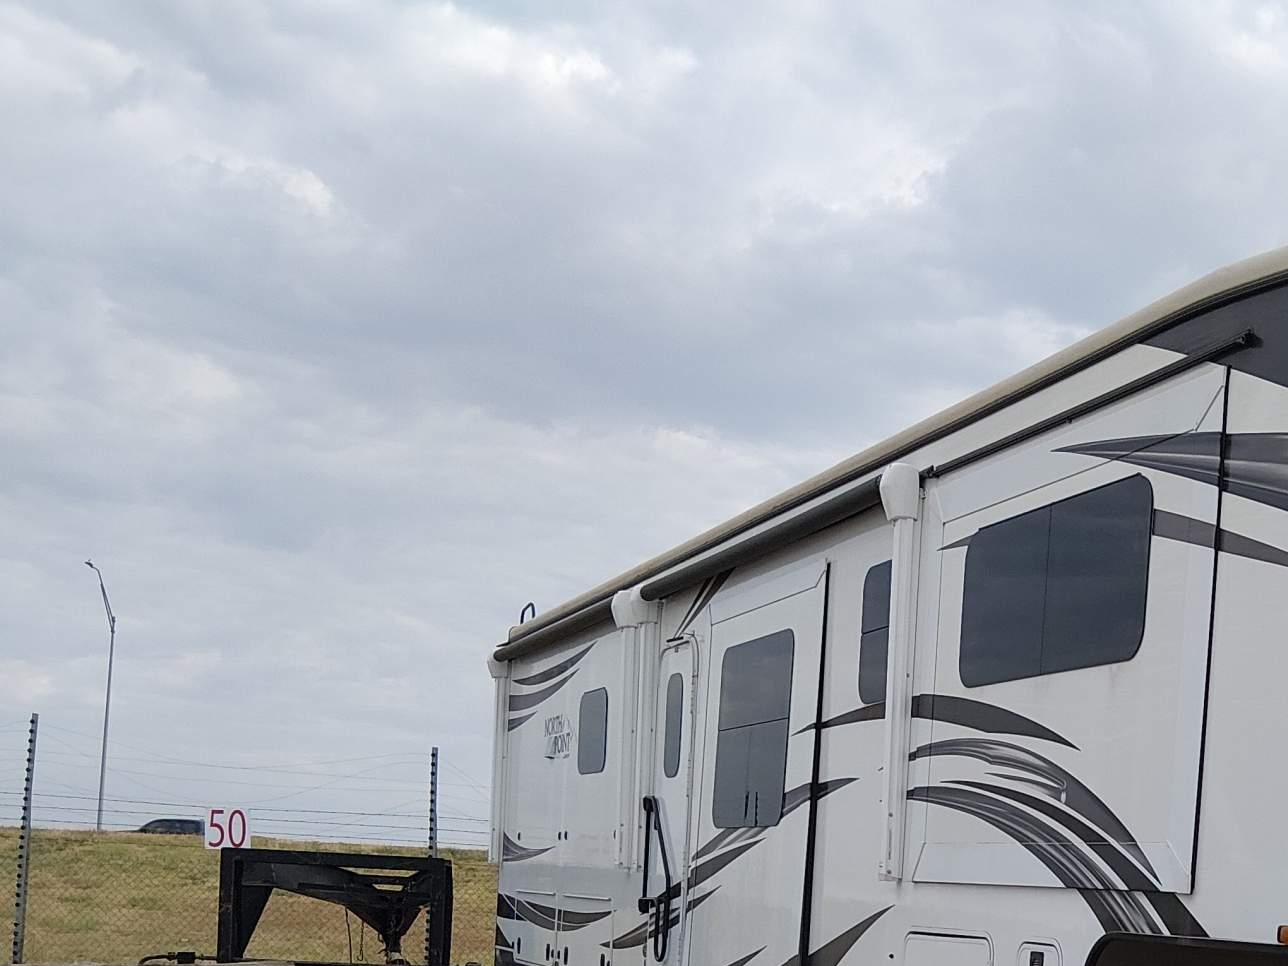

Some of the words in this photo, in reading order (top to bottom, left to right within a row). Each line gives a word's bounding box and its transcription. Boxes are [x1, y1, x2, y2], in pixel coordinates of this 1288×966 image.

[544, 714, 564, 738] NORTH
[553, 731, 571, 755] POINT
[208, 809, 247, 848] 50
